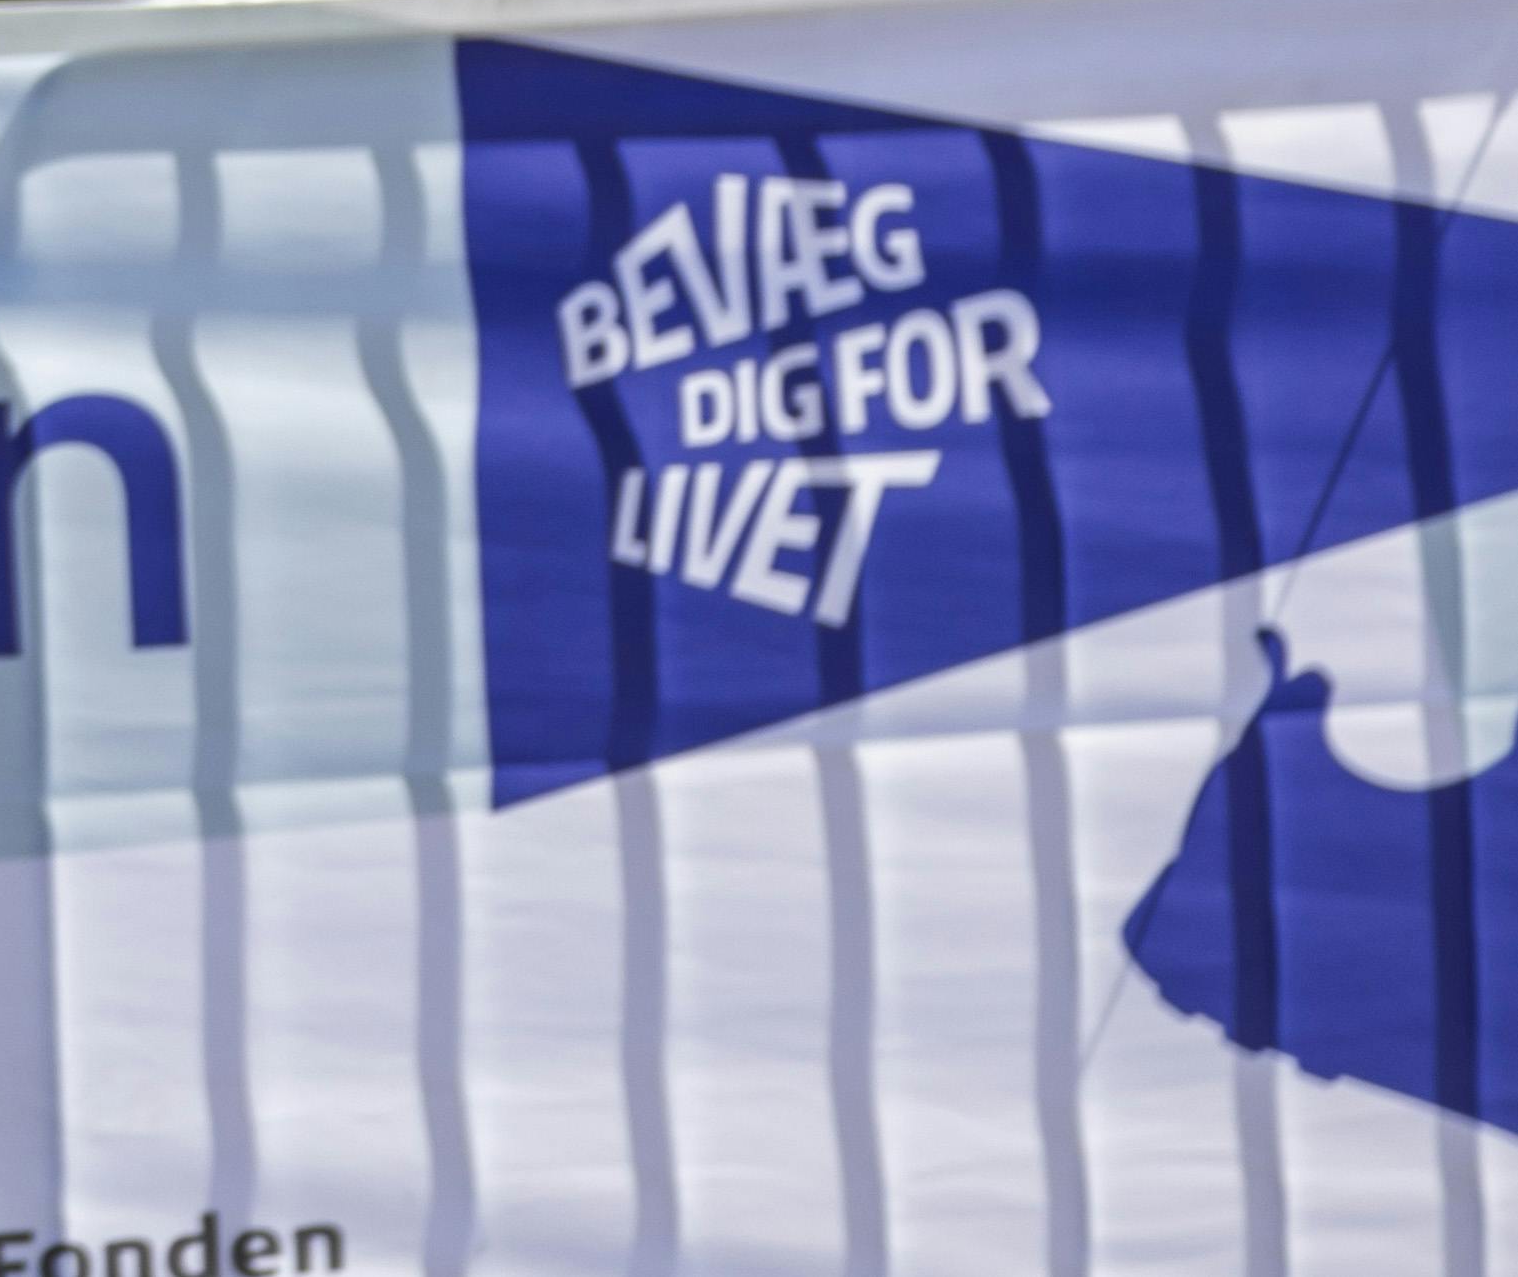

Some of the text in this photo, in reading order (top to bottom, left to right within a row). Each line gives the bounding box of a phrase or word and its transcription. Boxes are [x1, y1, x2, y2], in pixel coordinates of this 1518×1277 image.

[558, 173, 926, 389] BEVÆG
[681, 288, 1053, 447] DIG FOR
[611, 449, 941, 629] LIVET
